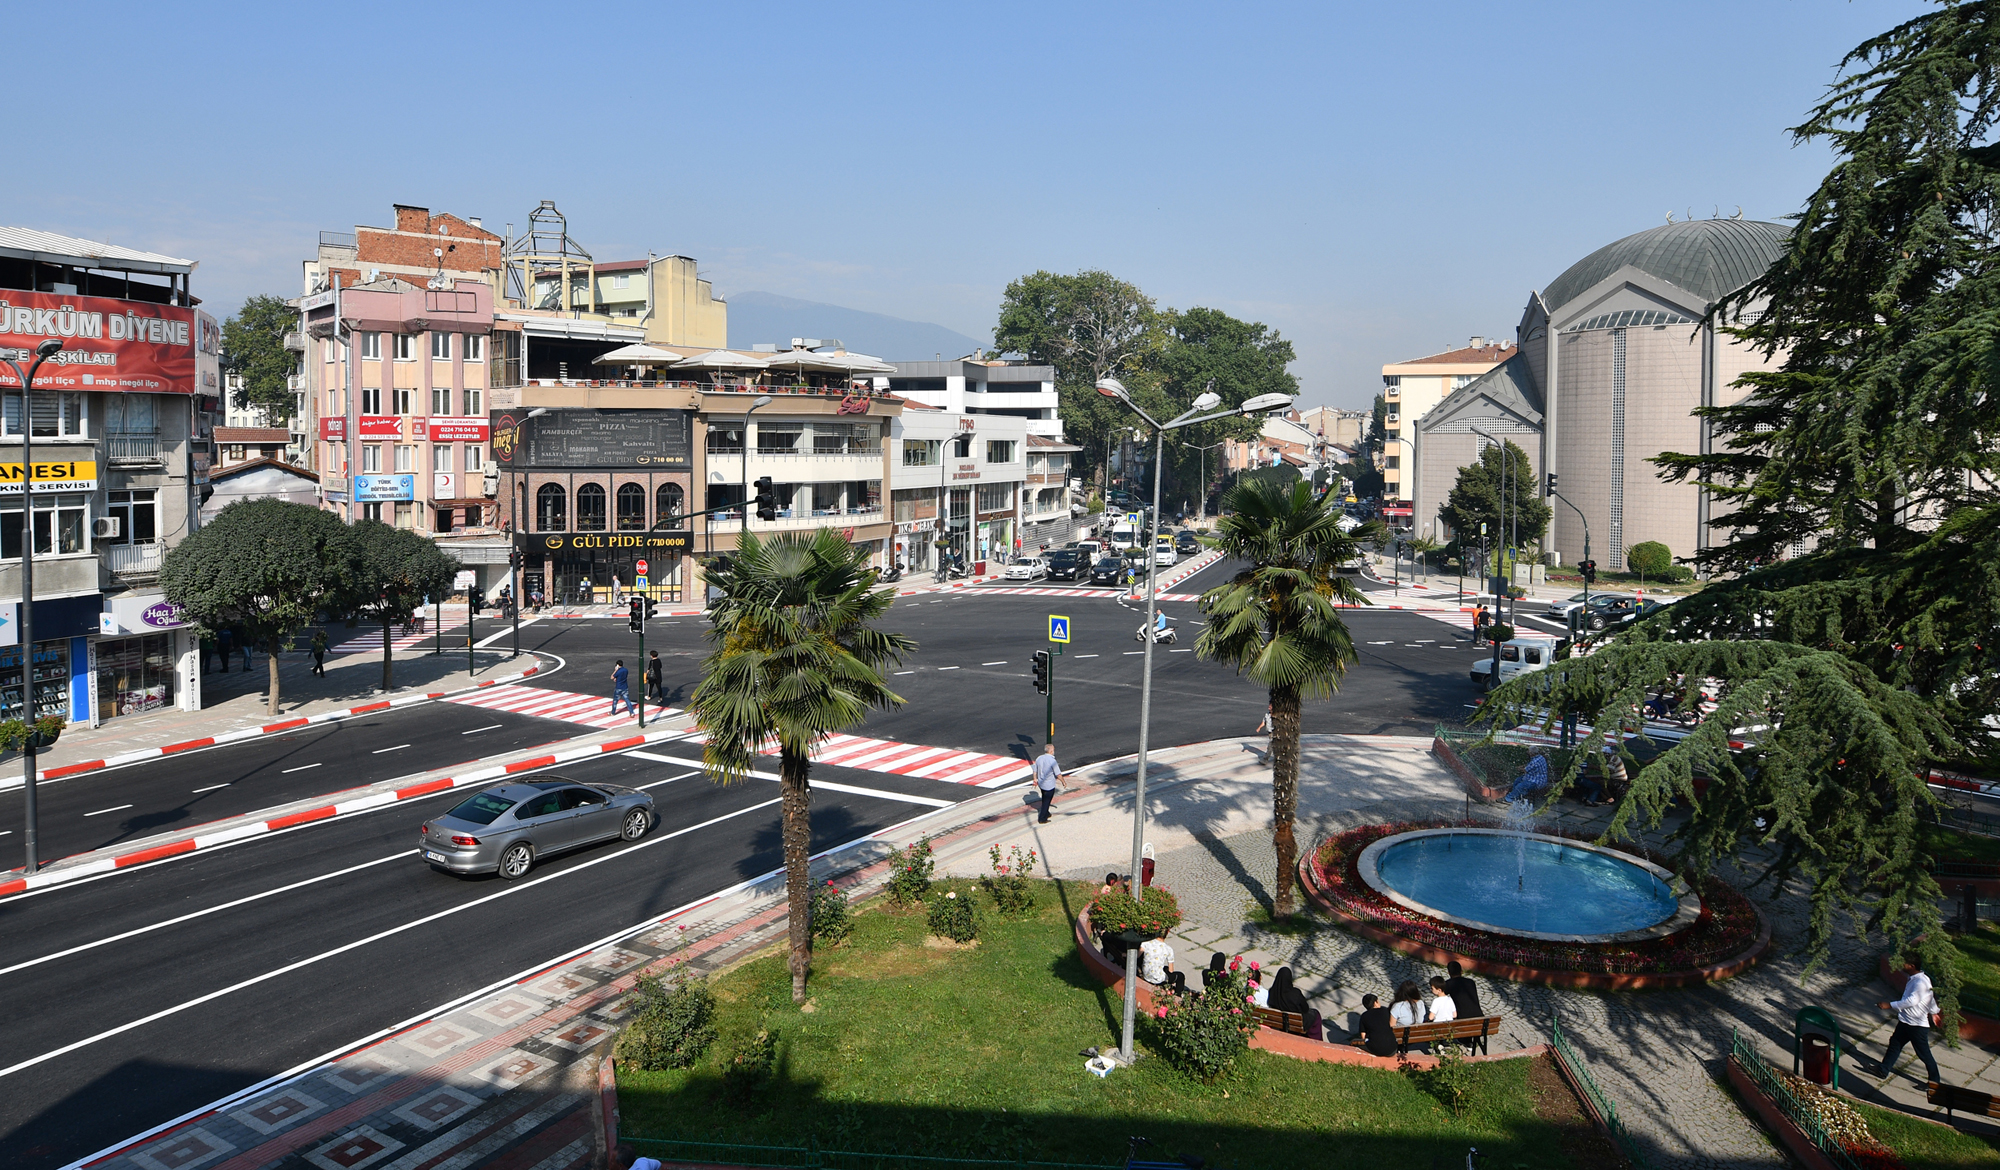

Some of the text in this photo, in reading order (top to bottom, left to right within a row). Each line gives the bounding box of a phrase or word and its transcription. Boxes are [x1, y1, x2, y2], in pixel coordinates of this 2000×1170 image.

[109, 310, 189, 346] DİYENE
[45, 350, 116, 366] EŞKİLATI
[55, 377, 75, 386] ilçe
[95, 378, 159, 388] mhp inegöl ilçe
[599, 421, 626, 431] PİZZA
[38, 482, 90, 490] SERVİSİ
[572, 533, 685, 548] GÜL PİDE 710 00 00
